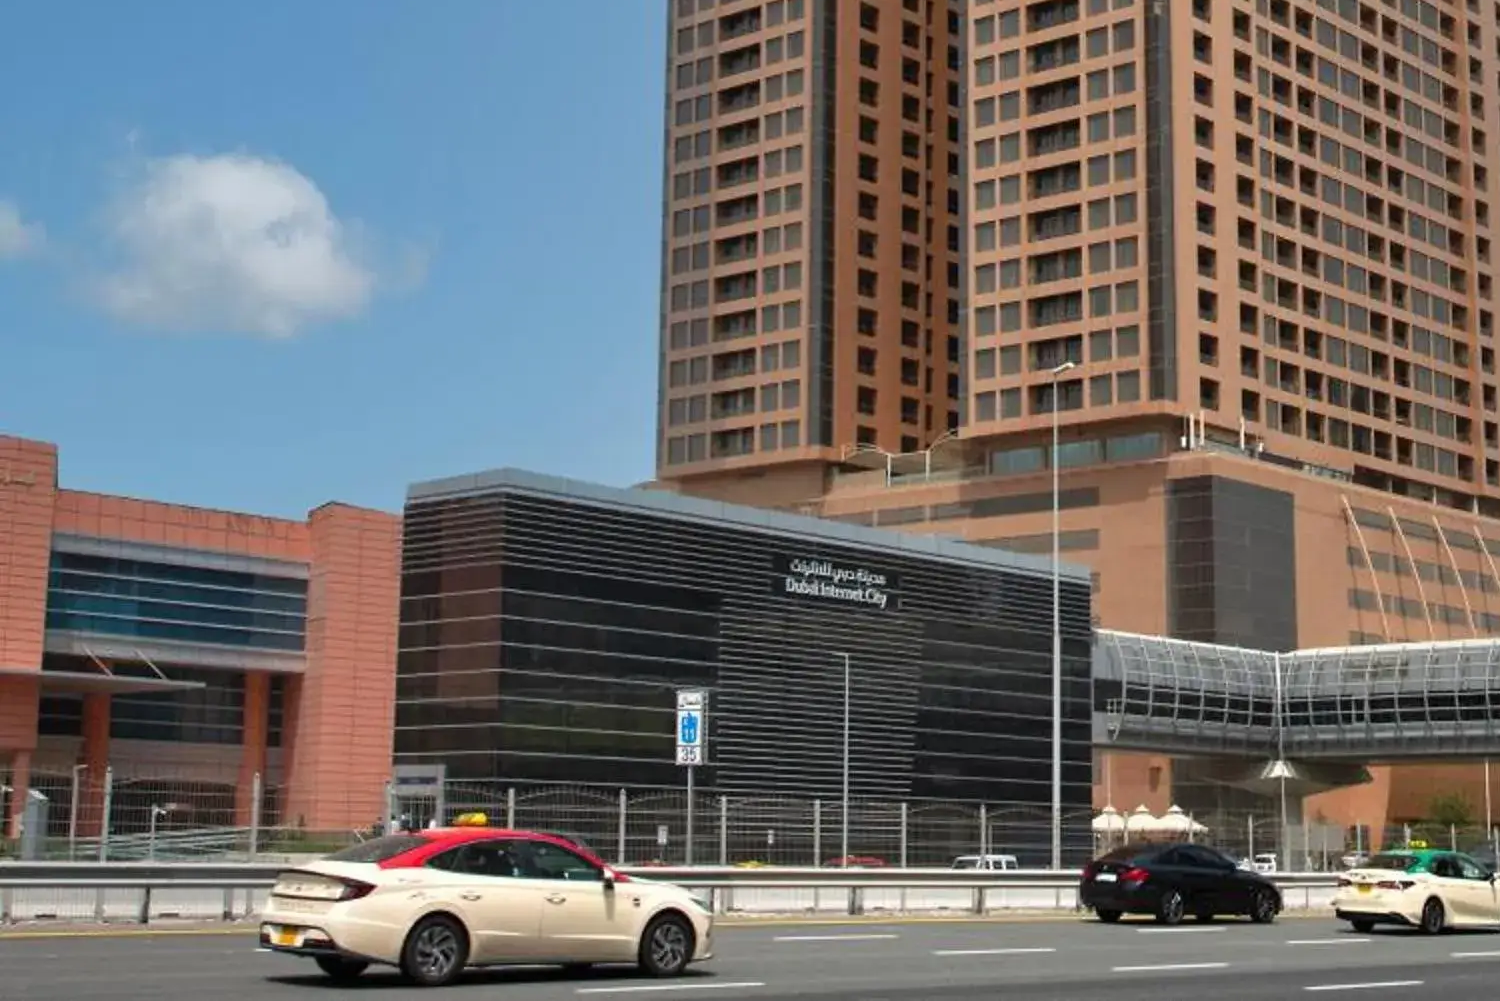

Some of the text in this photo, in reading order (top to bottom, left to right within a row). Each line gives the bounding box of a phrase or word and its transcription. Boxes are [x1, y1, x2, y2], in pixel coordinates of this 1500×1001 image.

[786, 578, 887, 608] Dubai Internet City
